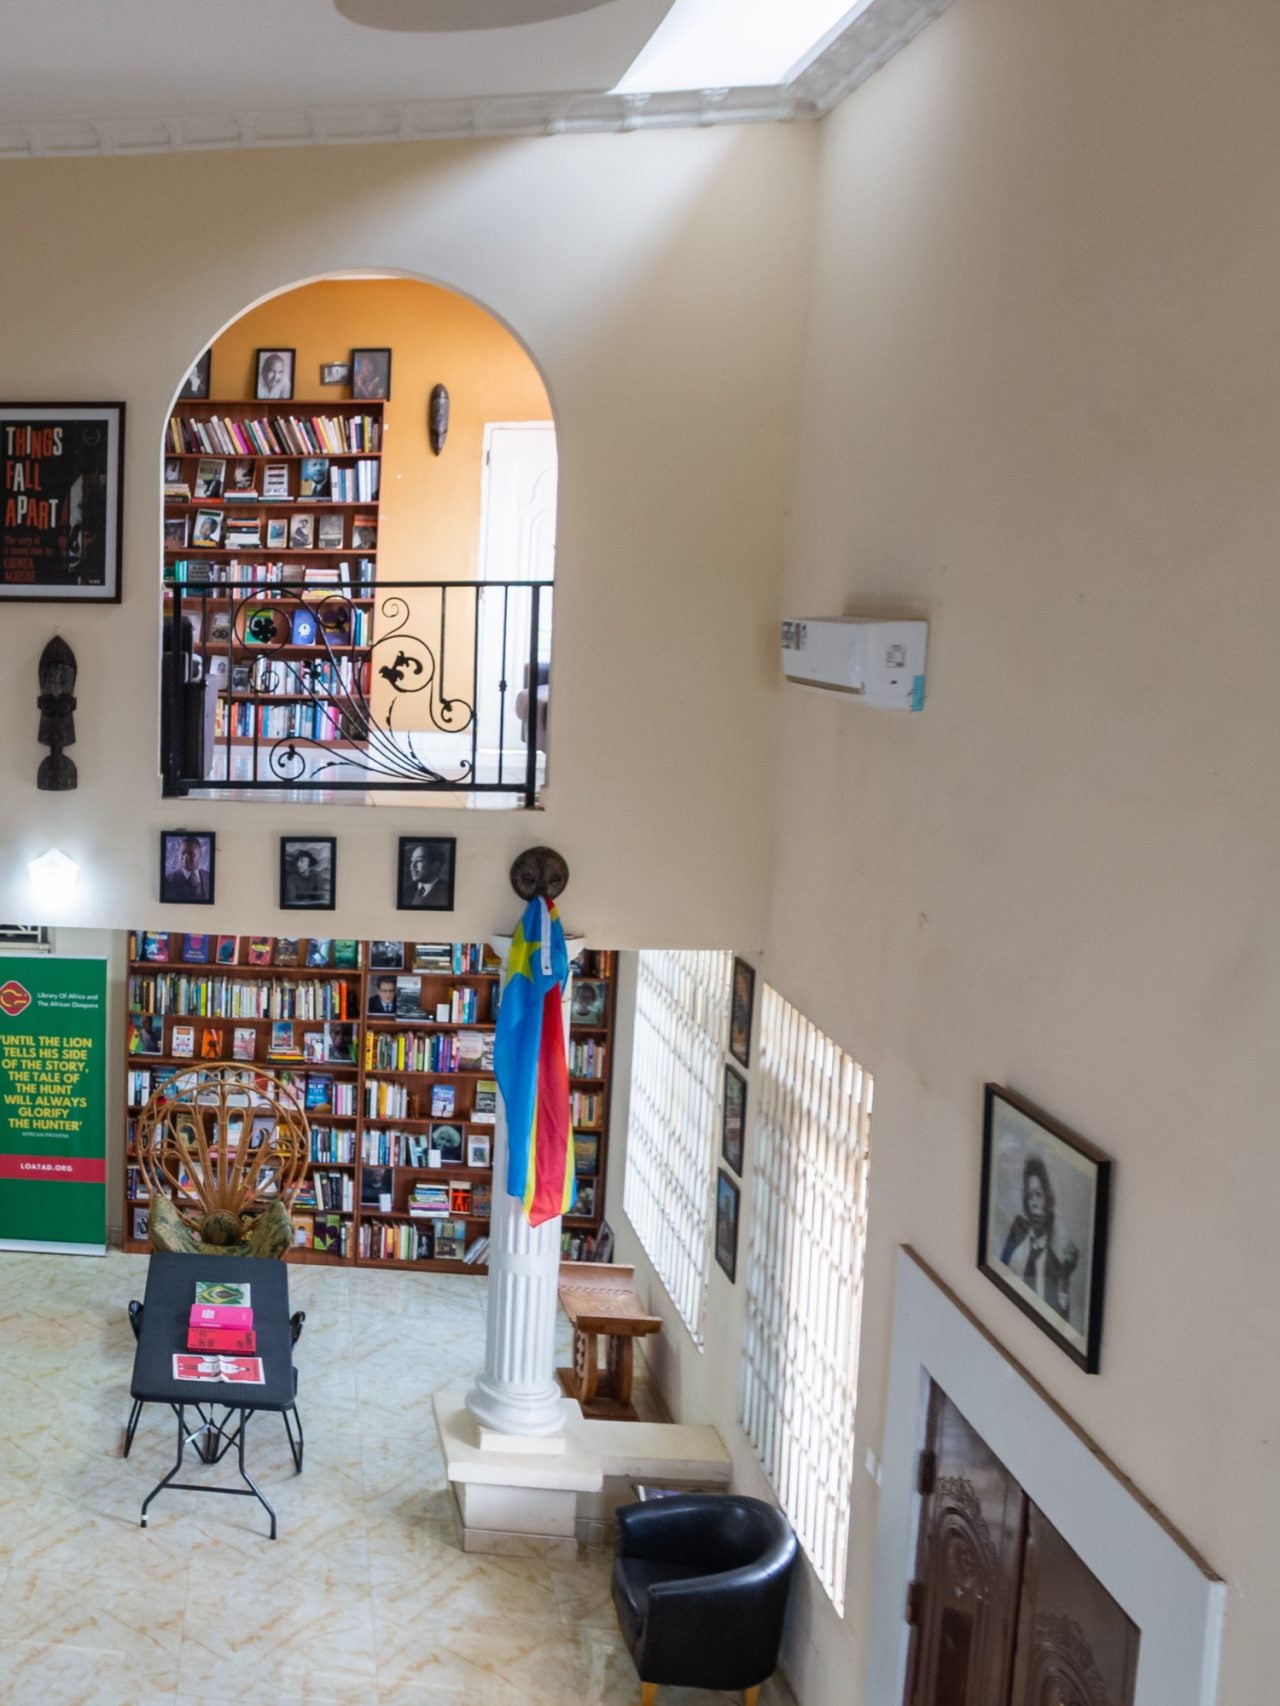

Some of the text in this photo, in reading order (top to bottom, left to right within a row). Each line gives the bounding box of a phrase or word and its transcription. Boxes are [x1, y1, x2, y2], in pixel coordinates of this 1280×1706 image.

[6, 426, 63, 459] THINGS
[5, 461, 42, 491] FALL
[5, 496, 59, 530] APART
[38, 1036, 61, 1047] THE
[63, 1037, 93, 1048] LION
[3, 1047, 88, 1060] TELLS HIS SIDE
[1, 1059, 89, 1073] OF THE STORY,
[8, 1071, 80, 1084] THE TALE OF
[15, 1083, 73, 1095] THE HUNT
[4, 1094, 87, 1108] WILL ALWAYS
[18, 1107, 70, 1119] GLORIFY
[8, 1118, 30, 1129] THE
[20, 1163, 73, 1172] LOATAD.ORG
